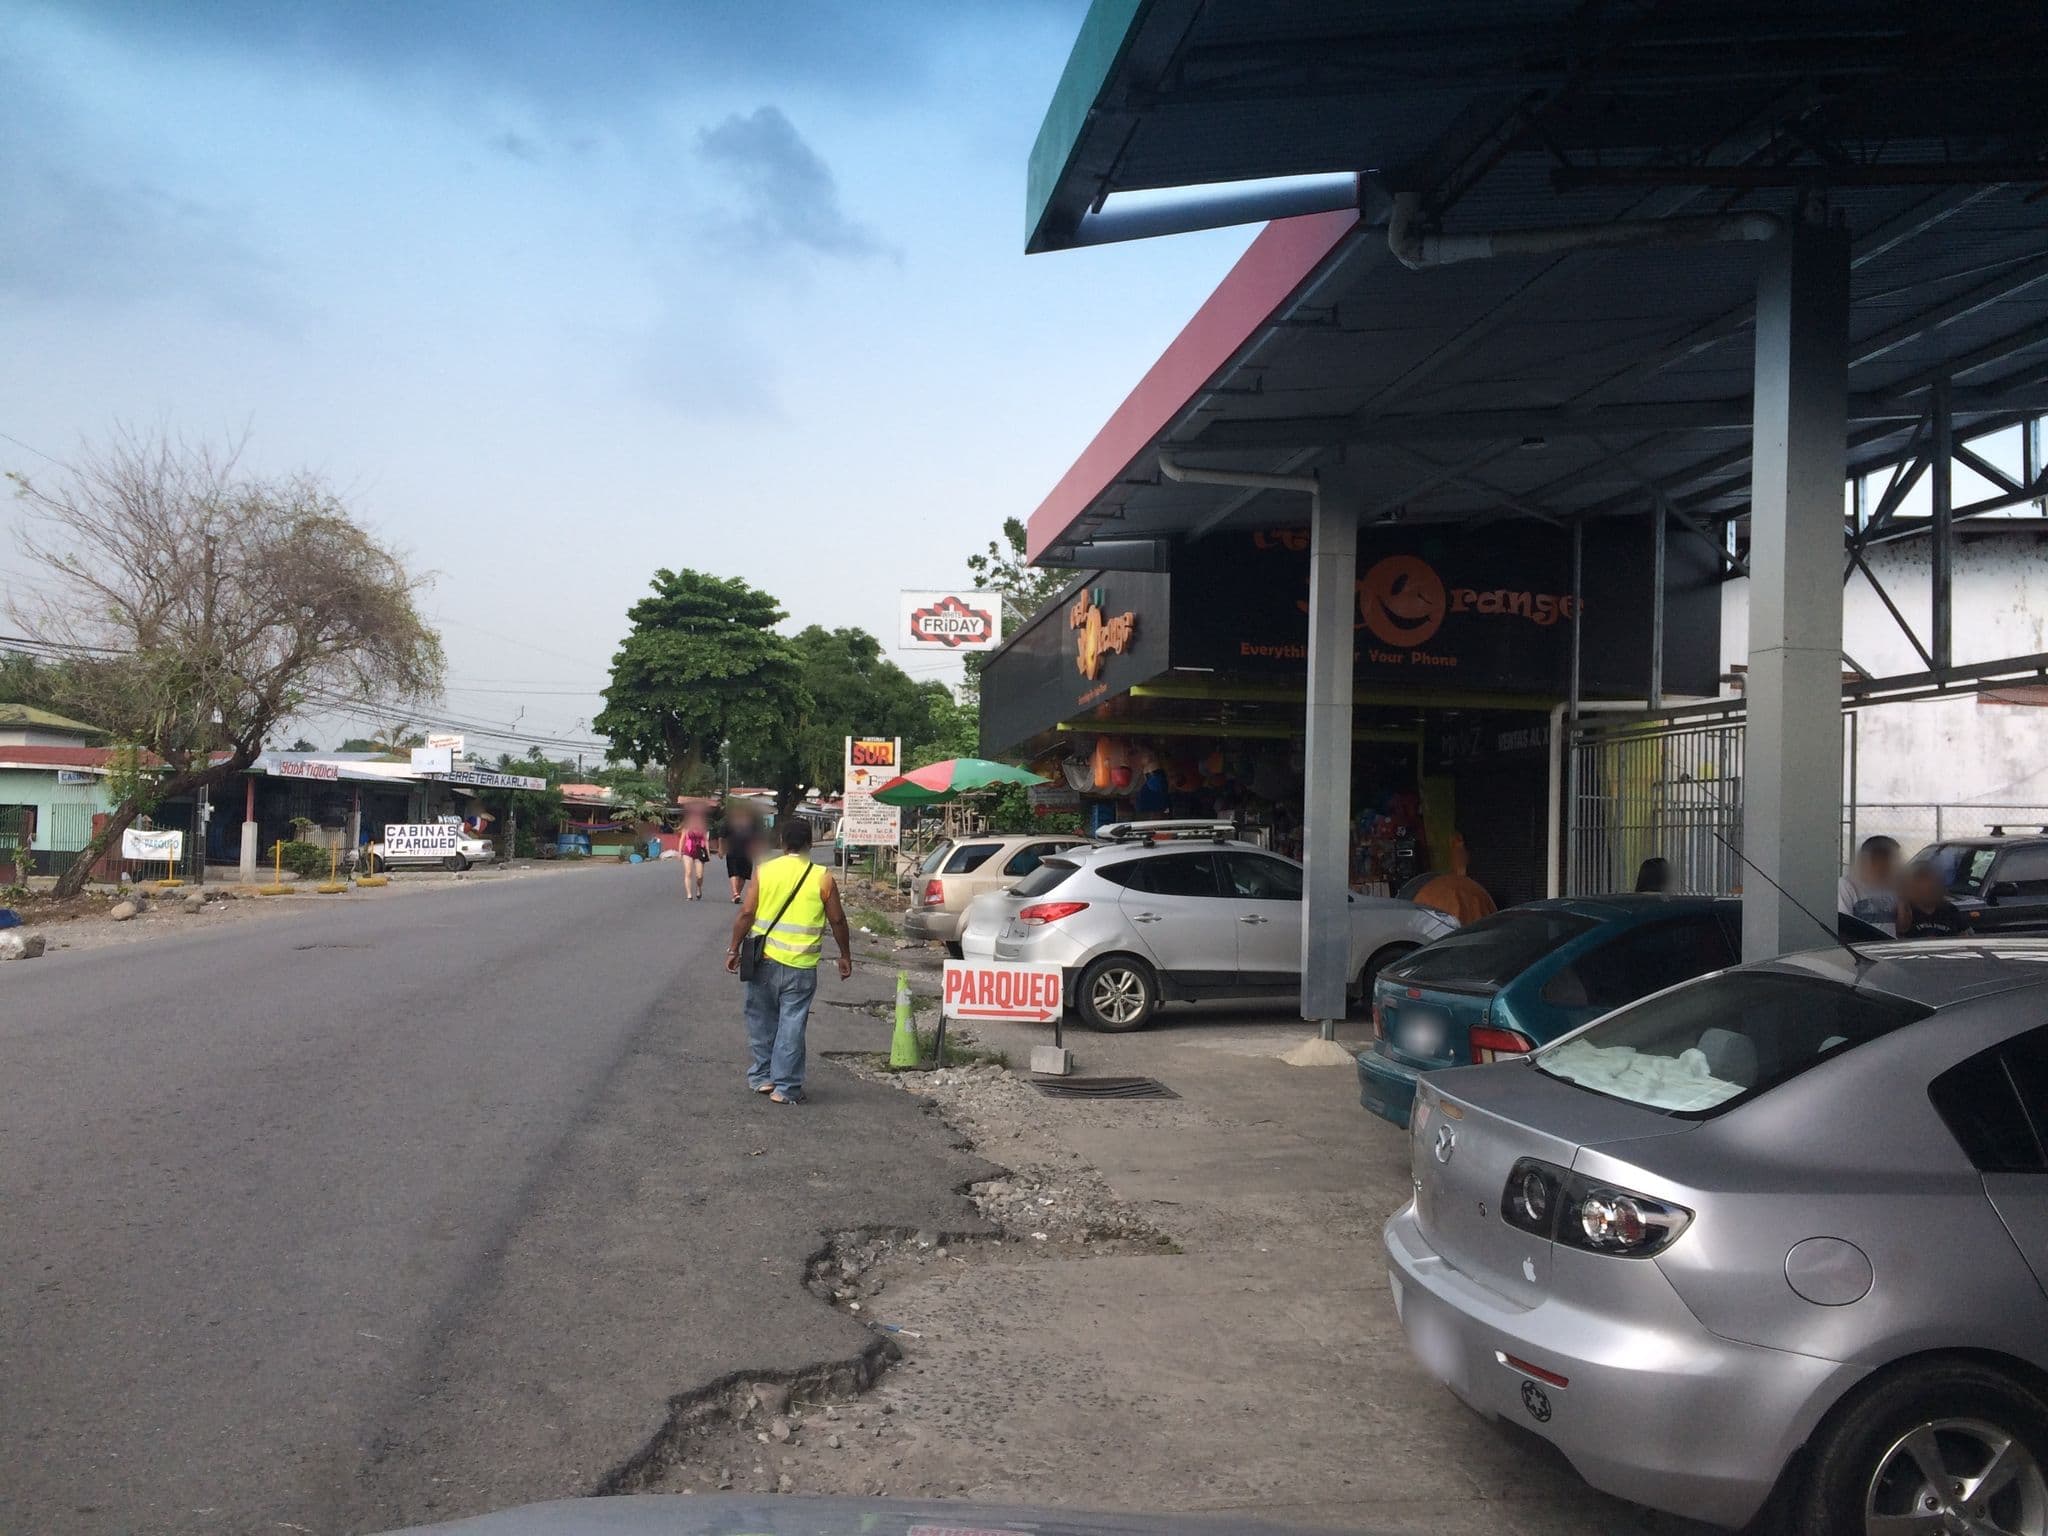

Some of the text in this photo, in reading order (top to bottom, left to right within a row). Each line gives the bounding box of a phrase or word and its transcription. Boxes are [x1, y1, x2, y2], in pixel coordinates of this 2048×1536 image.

[1240, 641, 1308, 660] Everythi
[1368, 648, 1404, 665] Your
[1410, 650, 1457, 666] Phone
[853, 744, 890, 765] SUR
[500, 773, 528, 788] KARLA
[386, 826, 457, 837] CABINAS
[387, 838, 455, 849] Y PARQUEO
[945, 969, 1059, 1009] PARQUEO
